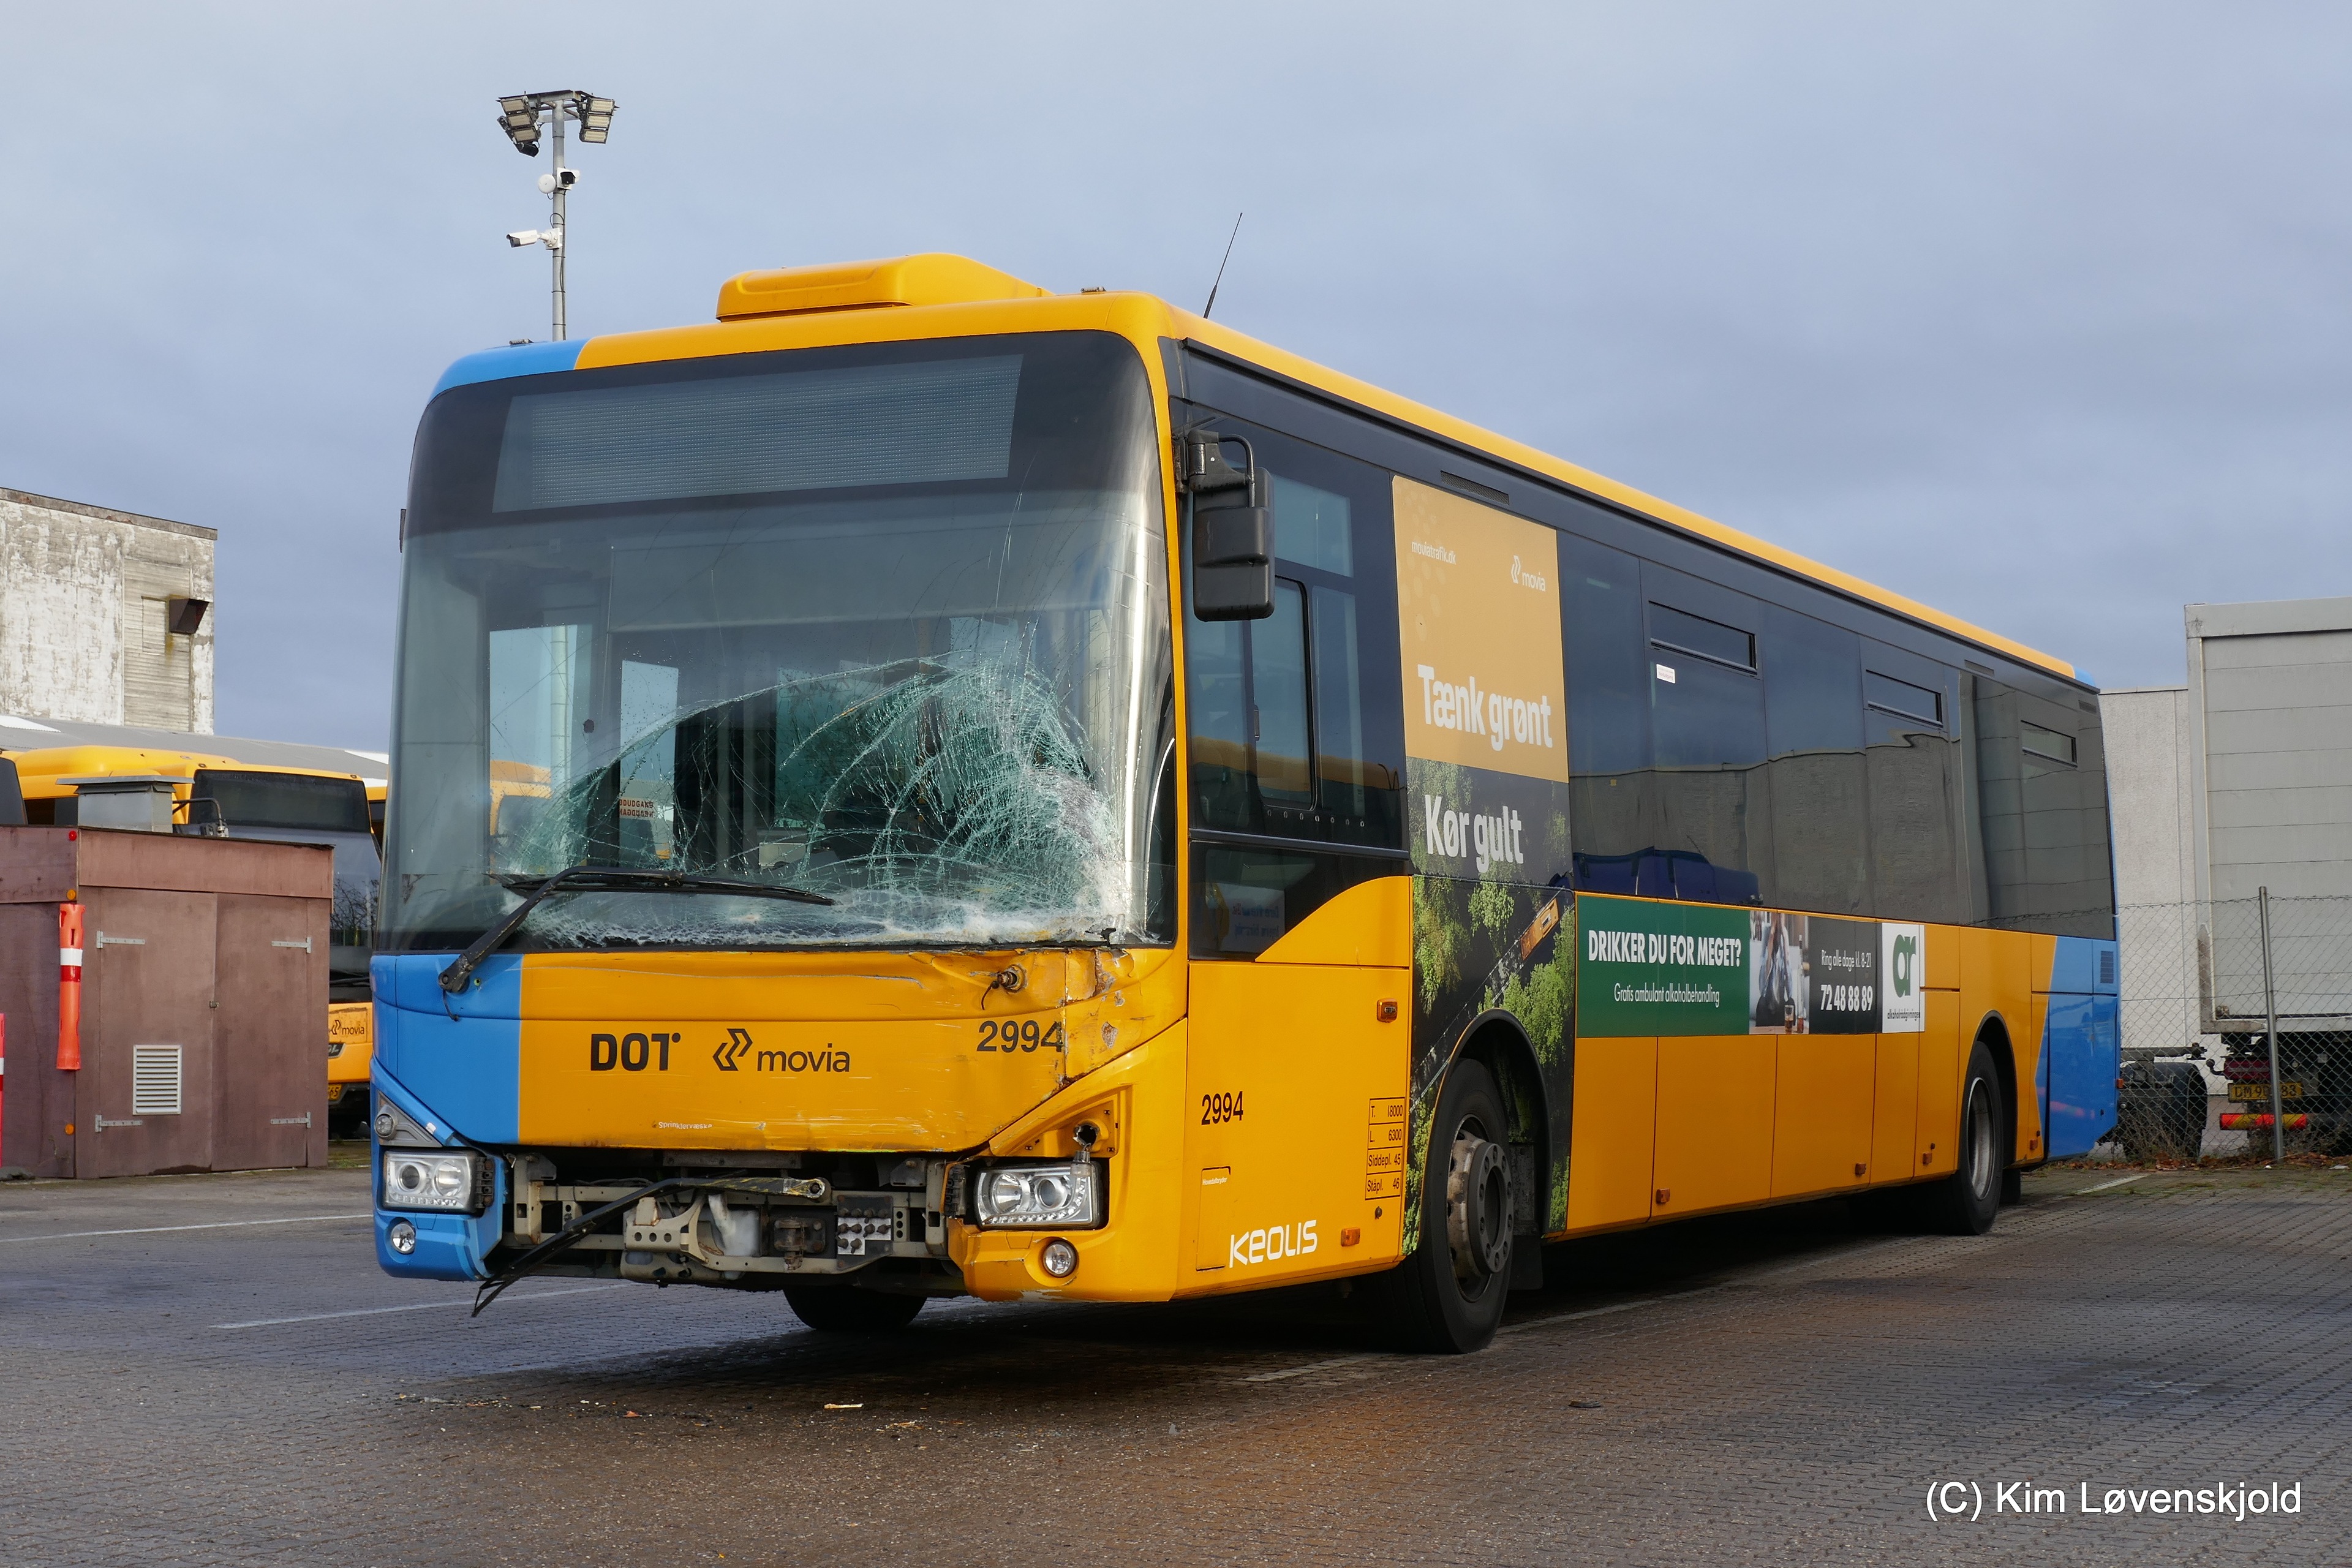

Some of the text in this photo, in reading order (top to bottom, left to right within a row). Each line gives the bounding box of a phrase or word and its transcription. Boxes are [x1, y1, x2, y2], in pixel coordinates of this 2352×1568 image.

[1411, 540, 1457, 565] moviatrafik.dk
[1521, 571, 1546, 592] movia
[1417, 664, 1553, 752] Tænk grønt
[1425, 794, 1524, 873] Kør gult
[1588, 930, 1742, 968] DRIKKER DU FOR MEGET?
[1821, 950, 1833, 971] Ring
[1833, 949, 1842, 967] alle
[1842, 951, 1855, 972] dage
[1861, 952, 1872, 968] 8-21
[1614, 982, 1720, 1008] Gratis ambulant alkoholbehandling
[1820, 984, 1873, 1011] 72 48 88 89
[342, 1023, 365, 1035] movia
[977, 1020, 1064, 1053] 2994
[591, 1033, 681, 1071] DOT
[757, 1043, 850, 1072] movia
[1201, 1091, 1244, 1125] 2994
[1371, 1104, 1403, 1118] T. 18000
[1369, 1128, 1402, 1143] L. 6300
[1368, 1153, 1401, 1169] Siddepl. 45
[1366, 1177, 1400, 1195] Ståpl. 46
